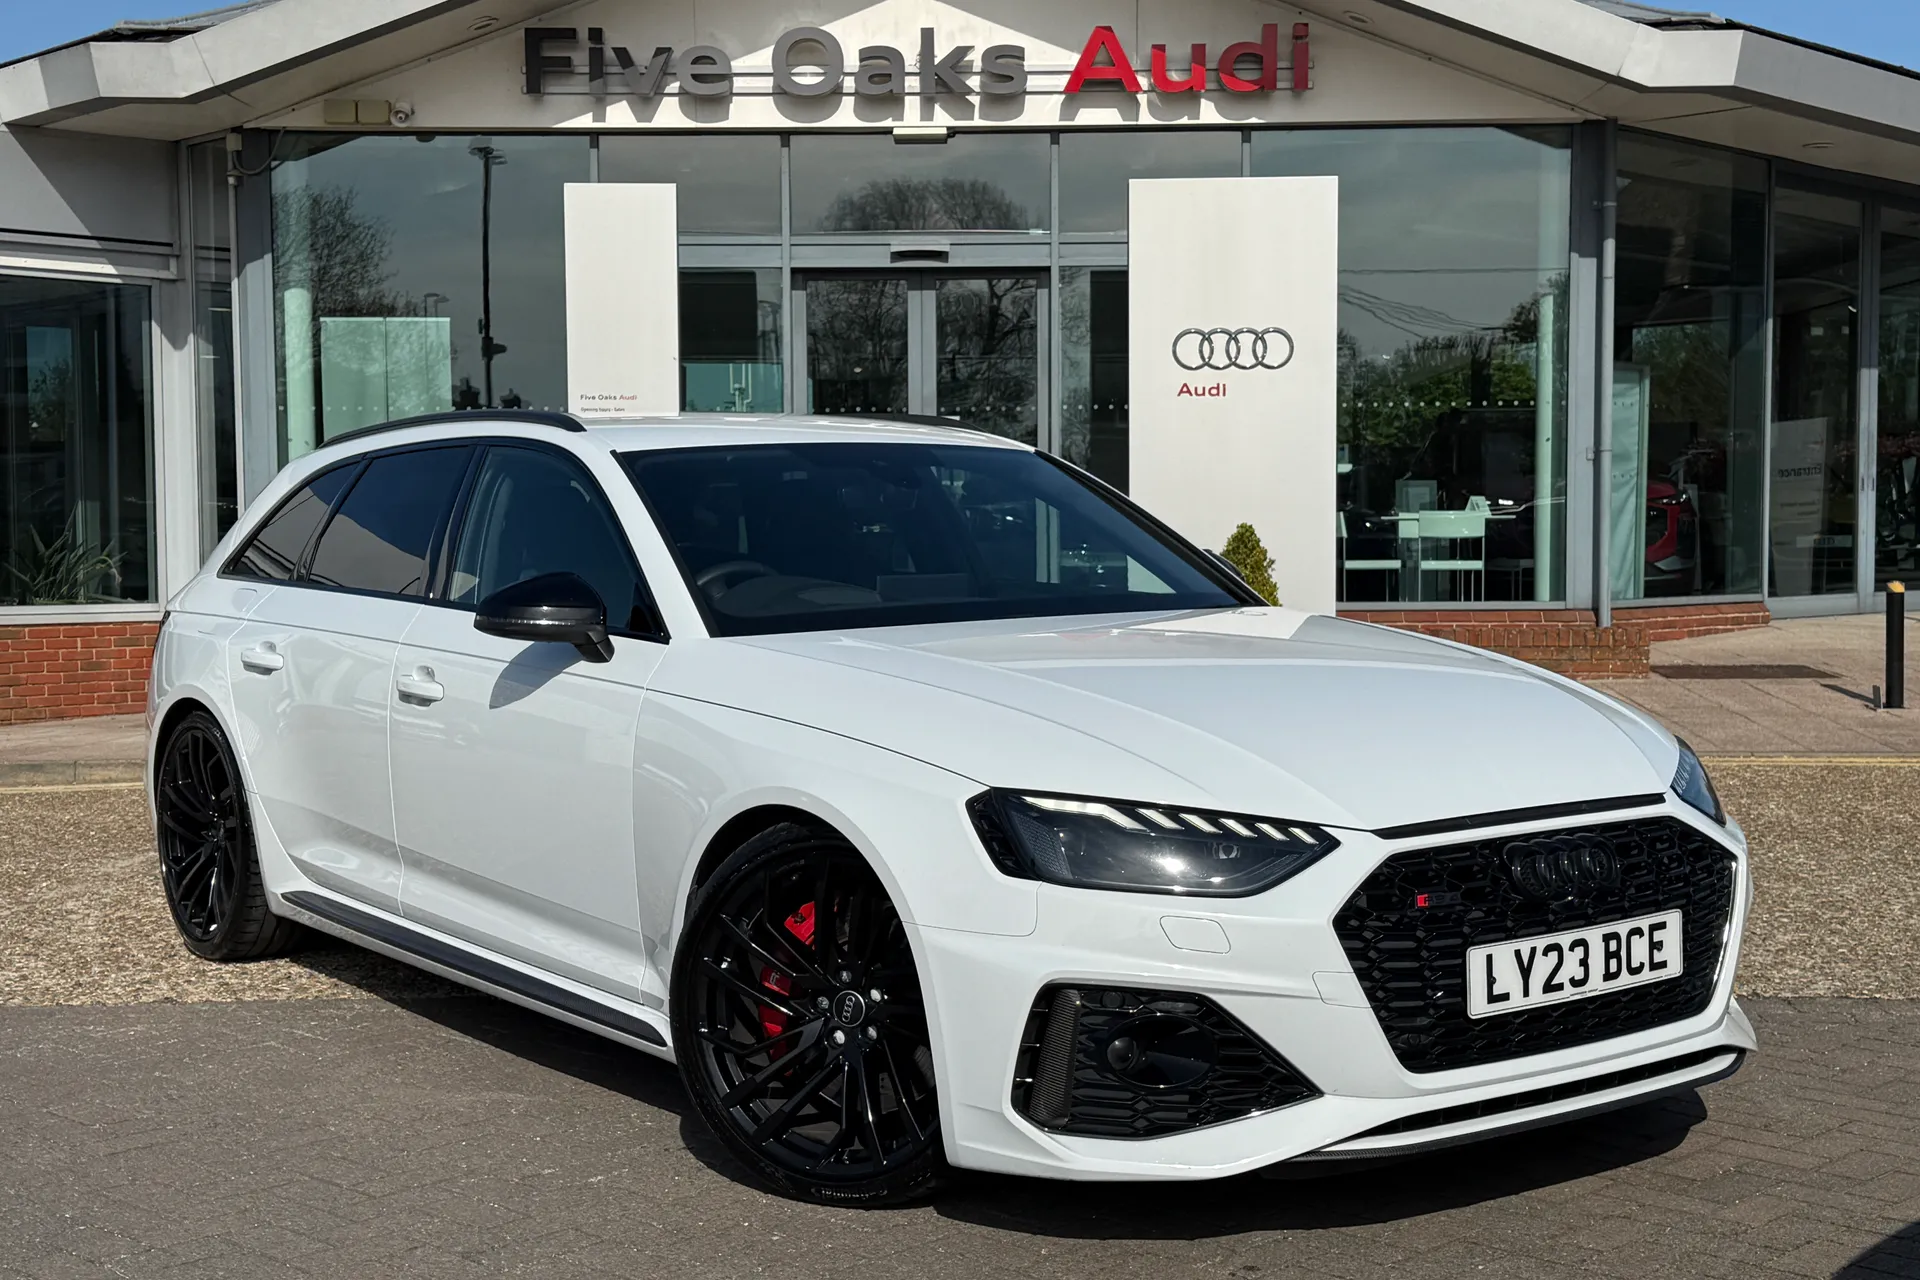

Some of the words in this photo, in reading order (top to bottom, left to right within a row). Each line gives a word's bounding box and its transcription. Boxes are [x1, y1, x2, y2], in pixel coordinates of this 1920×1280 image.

[524, 26, 733, 97] Five
[772, 26, 1028, 97] Oaks
[1063, 22, 1310, 94] Audi
[1177, 382, 1227, 397] Audi
[1486, 937, 1590, 1005] LY23
[1602, 921, 1668, 982] BCE
